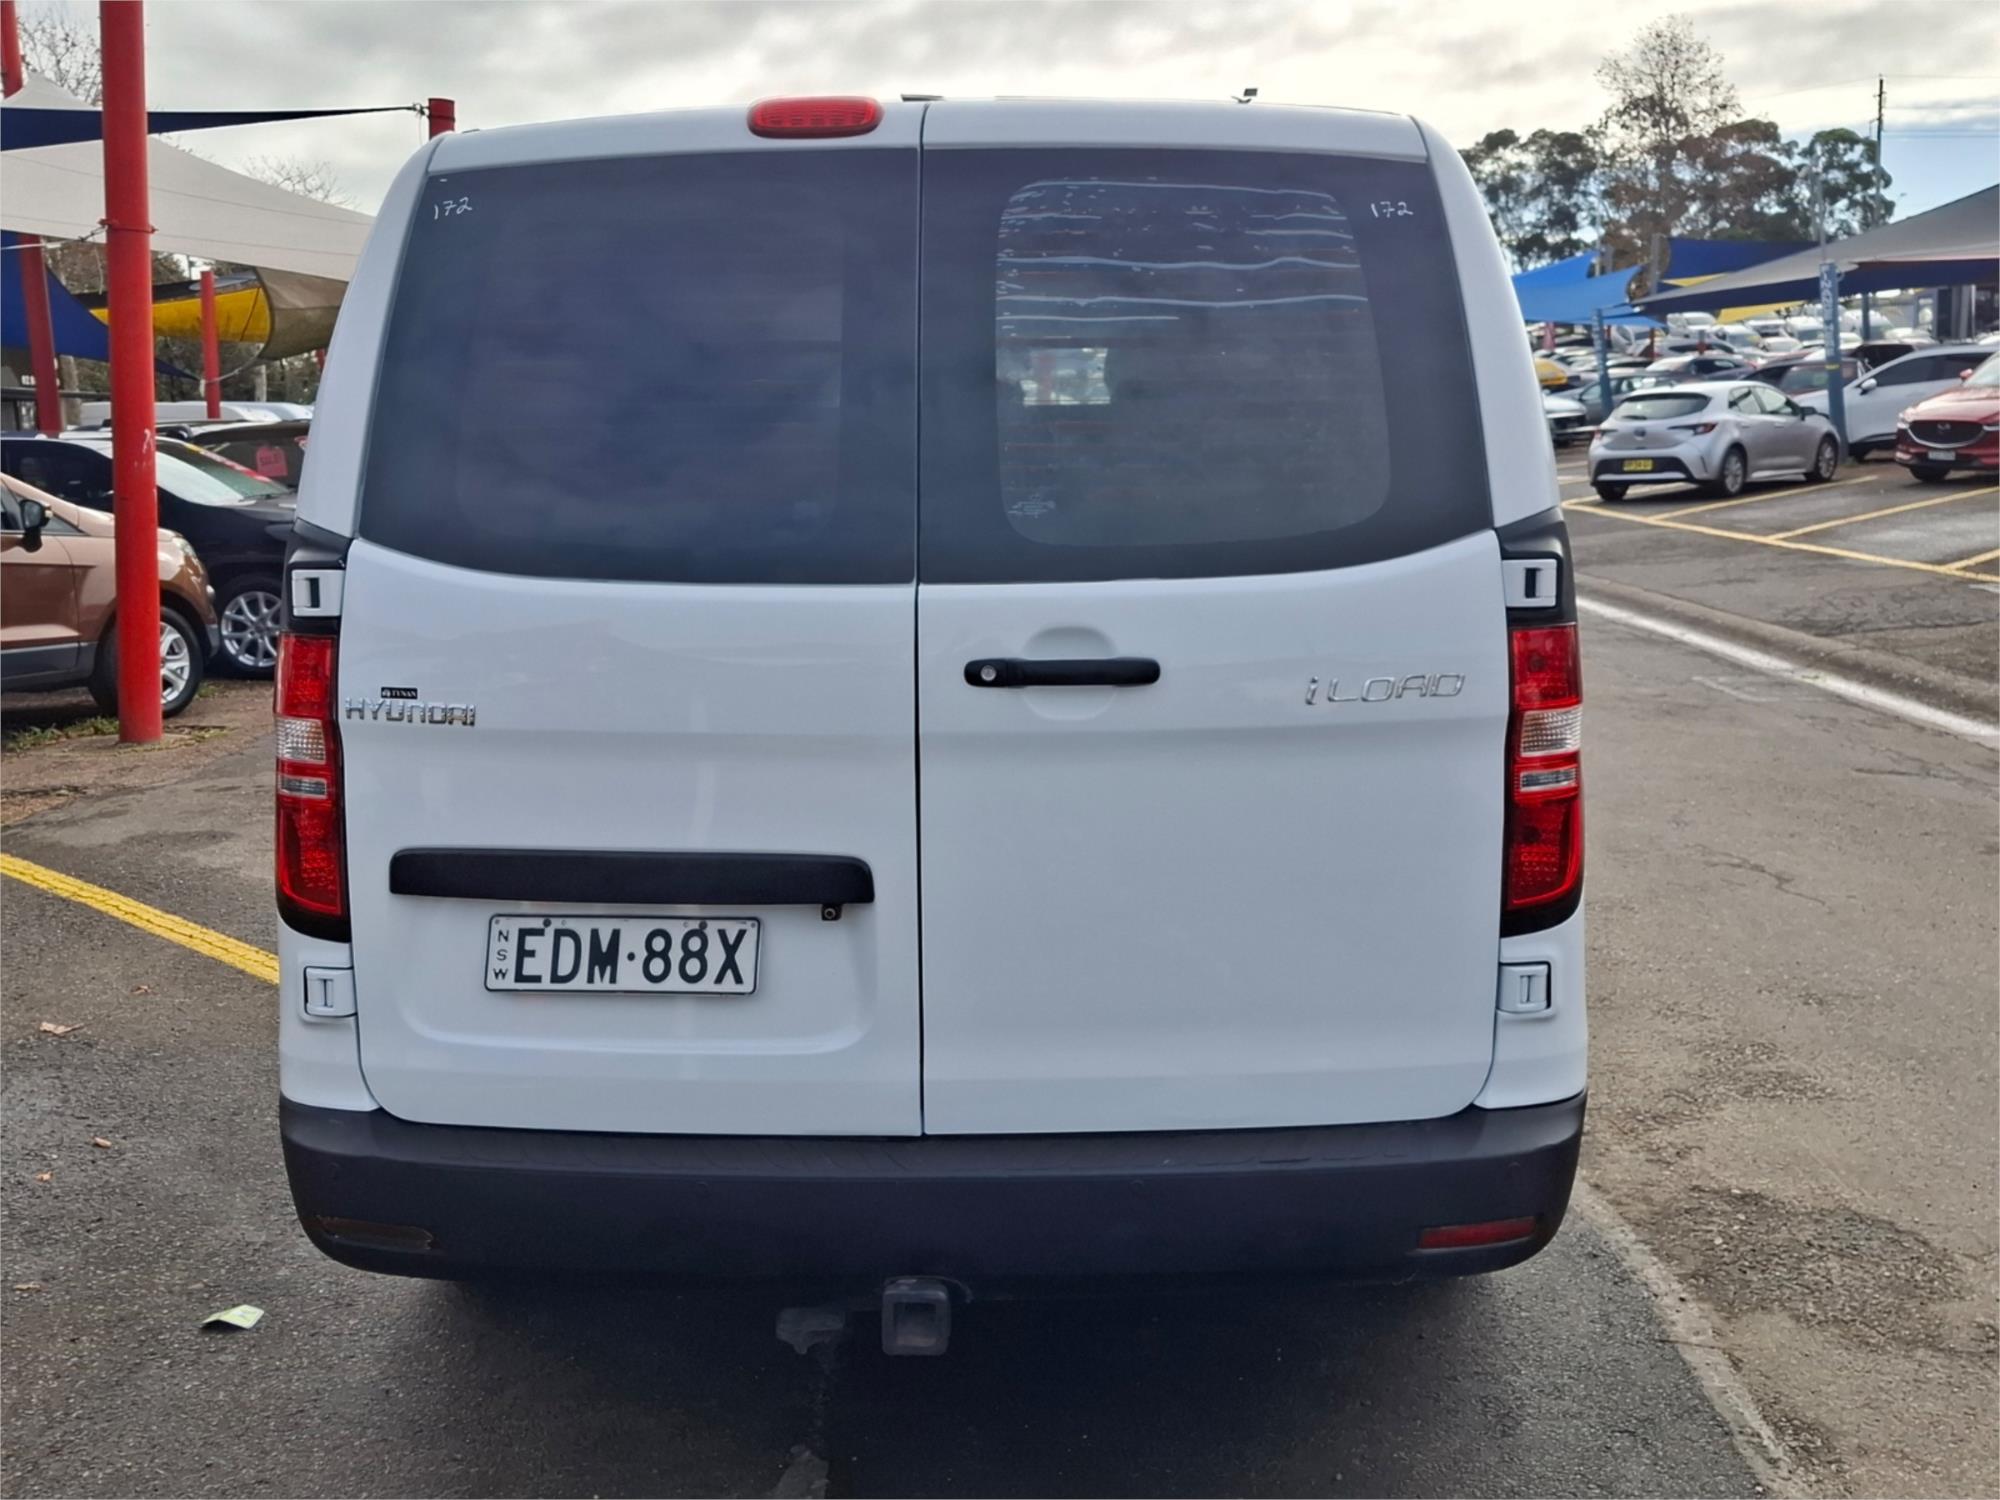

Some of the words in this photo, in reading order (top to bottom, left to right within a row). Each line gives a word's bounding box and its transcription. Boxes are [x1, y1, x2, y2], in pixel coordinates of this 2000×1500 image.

[433, 196, 473, 220] 172
[1370, 201, 1414, 218] 172
[345, 698, 476, 726] HYUNDAI
